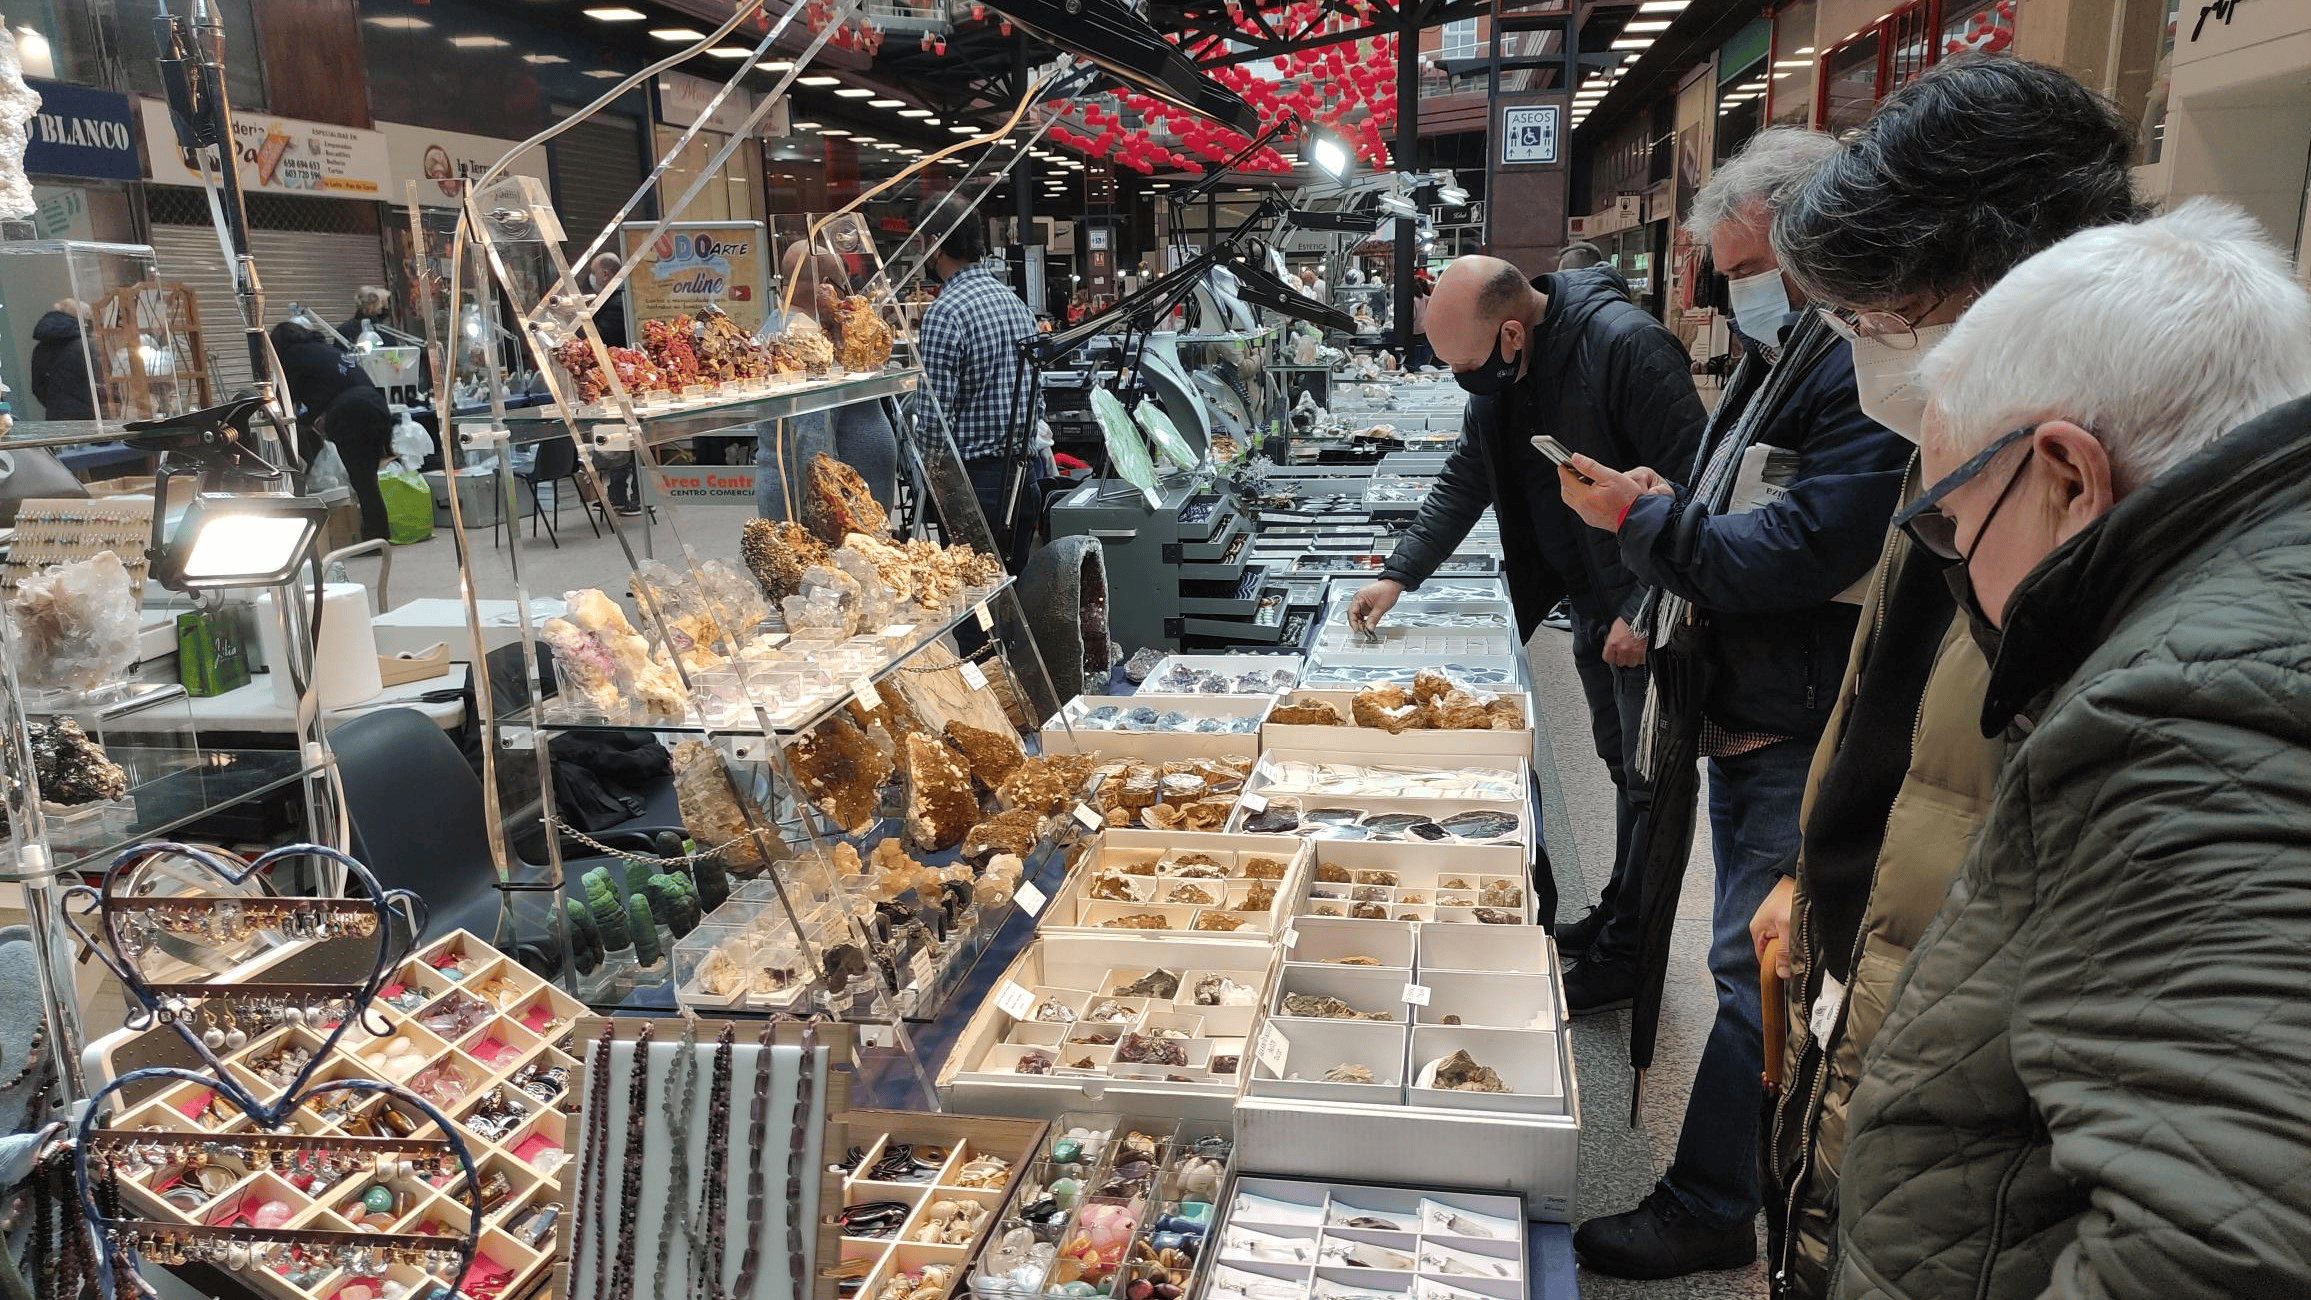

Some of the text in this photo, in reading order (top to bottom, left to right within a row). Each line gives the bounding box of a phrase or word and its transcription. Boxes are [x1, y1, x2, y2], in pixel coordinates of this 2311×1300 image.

[1512, 112, 1551, 124] ASEOS
[38, 113, 130, 151] BLANCO
[283, 159, 295, 168] 658
[309, 160, 320, 170] 653
[672, 273, 724, 293] online
